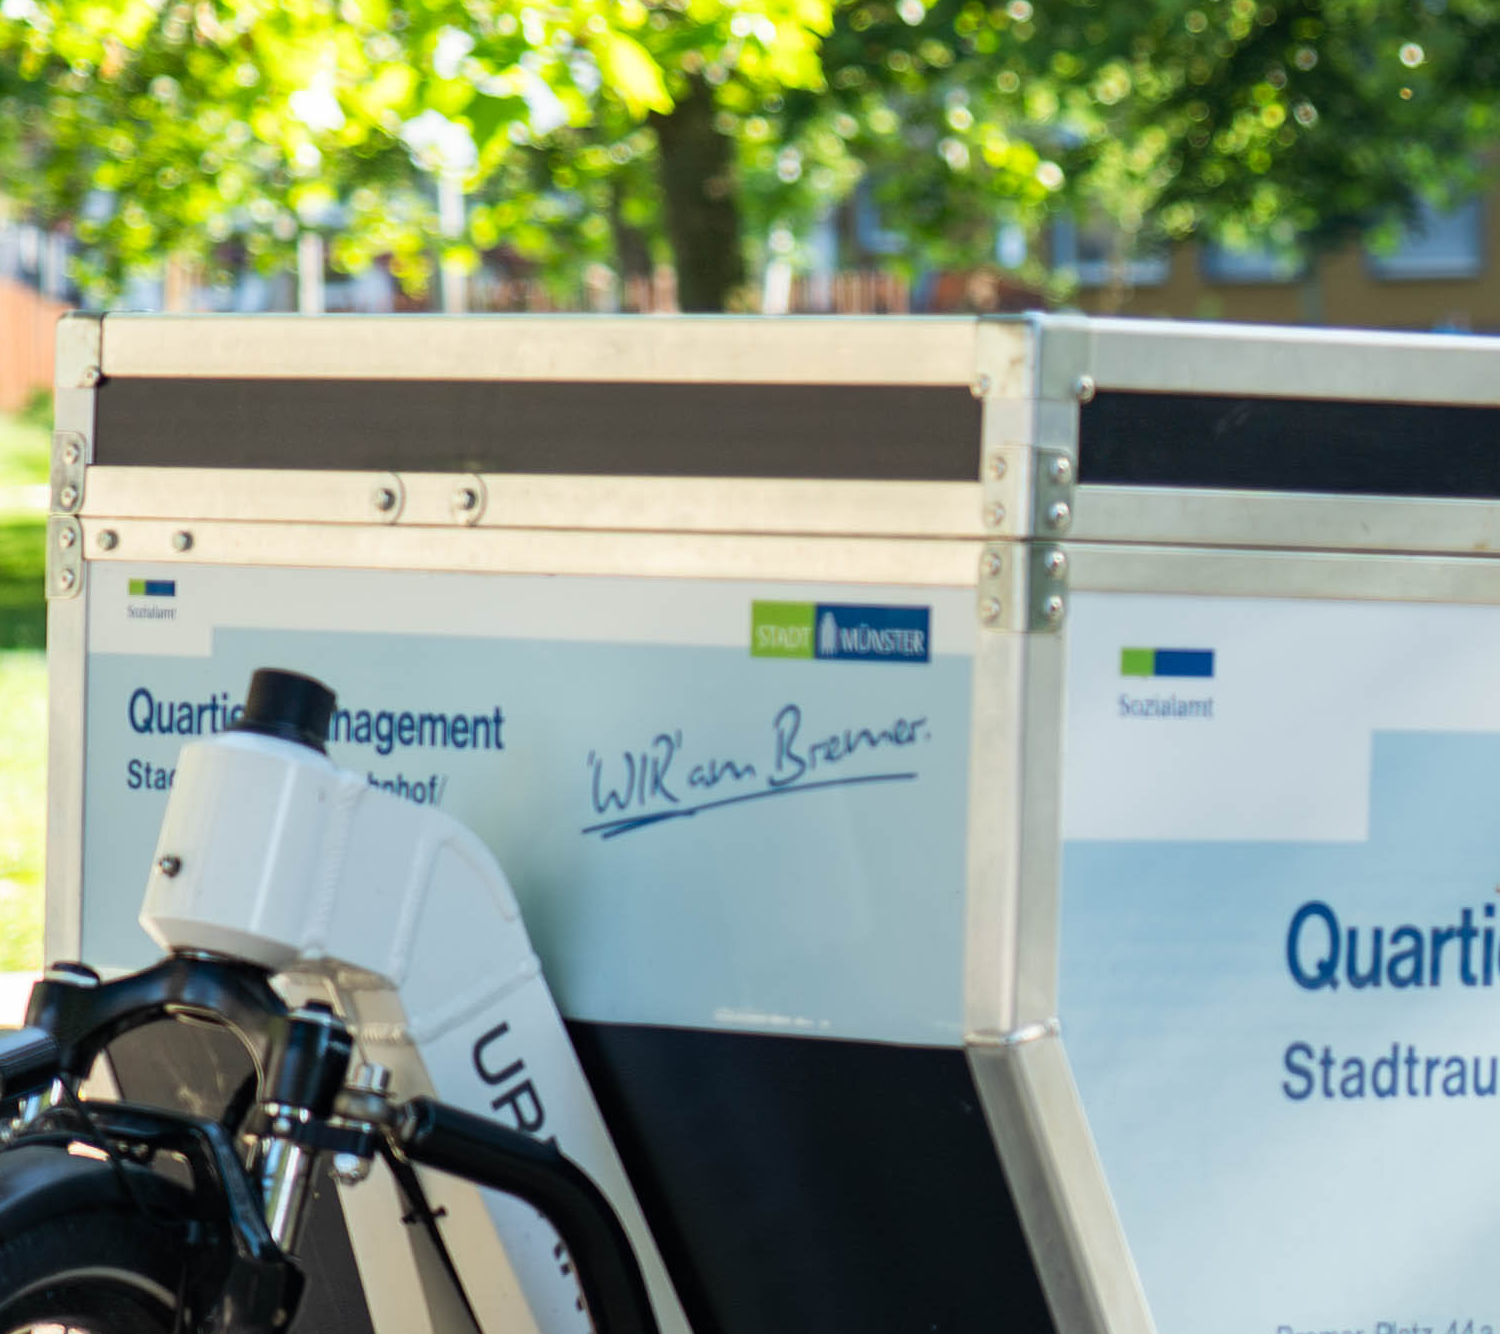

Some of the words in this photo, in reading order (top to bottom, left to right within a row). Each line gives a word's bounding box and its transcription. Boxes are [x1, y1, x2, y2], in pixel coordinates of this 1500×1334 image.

[757, 623, 812, 649] STADT
[839, 622, 925, 655] MÜNSTER
[1118, 691, 1214, 719] Sozialamt
[687, 758, 756, 789] am
